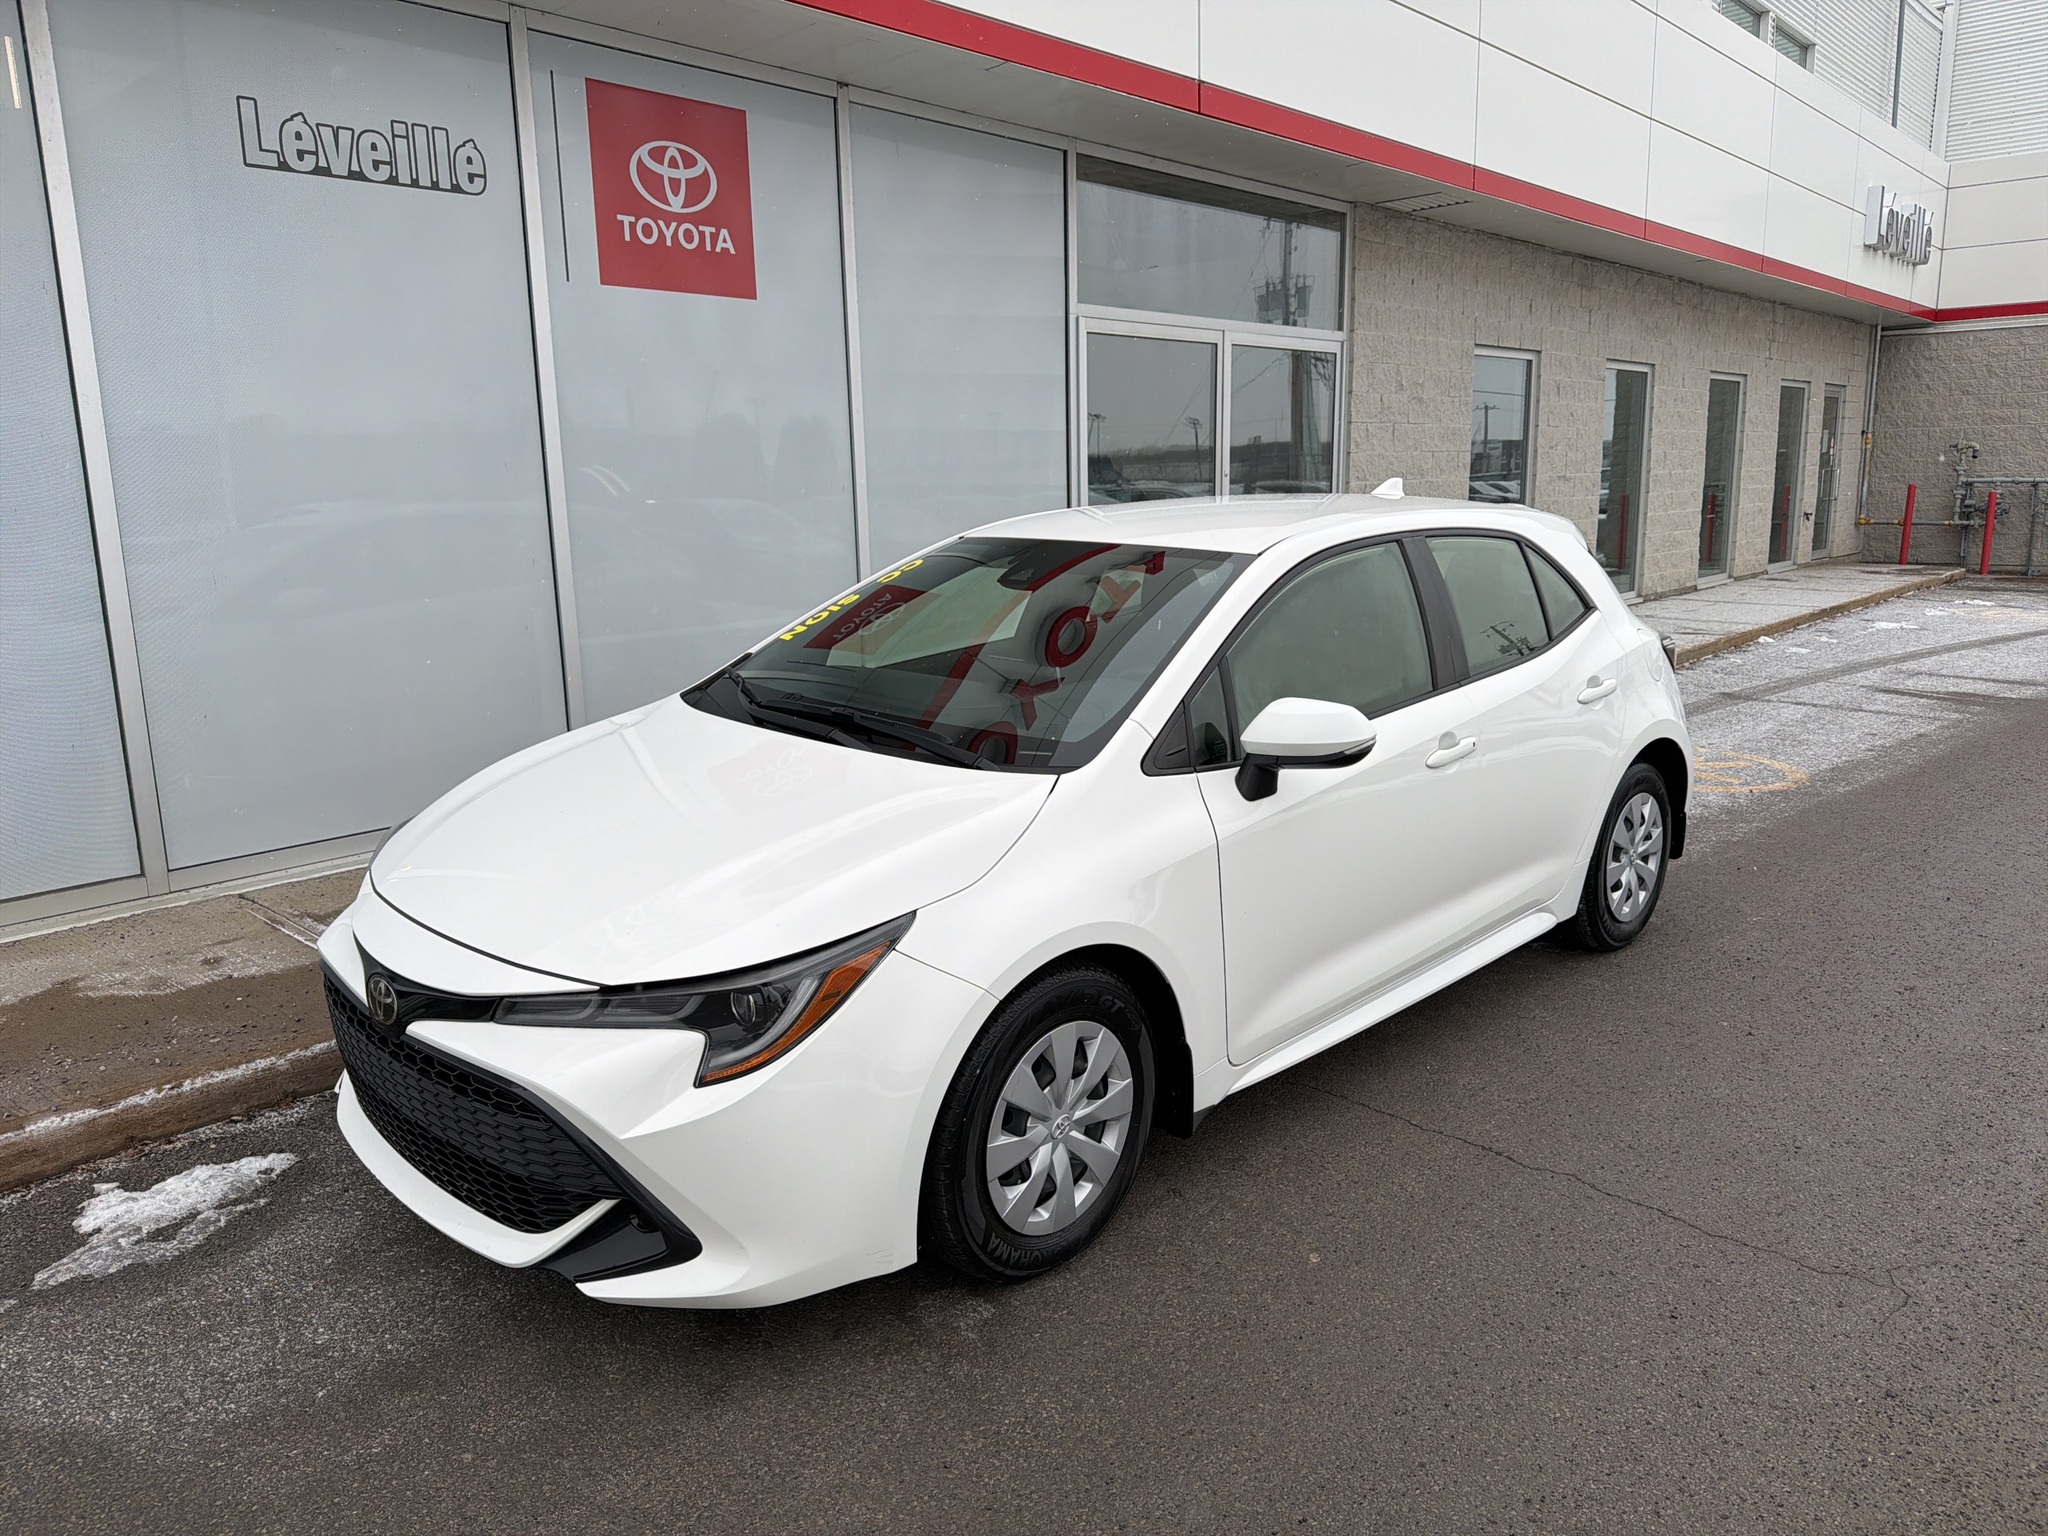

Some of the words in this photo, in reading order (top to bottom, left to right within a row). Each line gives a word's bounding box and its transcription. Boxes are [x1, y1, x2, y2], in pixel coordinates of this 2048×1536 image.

[236, 95, 487, 196] Léveillé
[616, 213, 736, 255] TOYOTA
[1863, 184, 1934, 266] Léveillé
